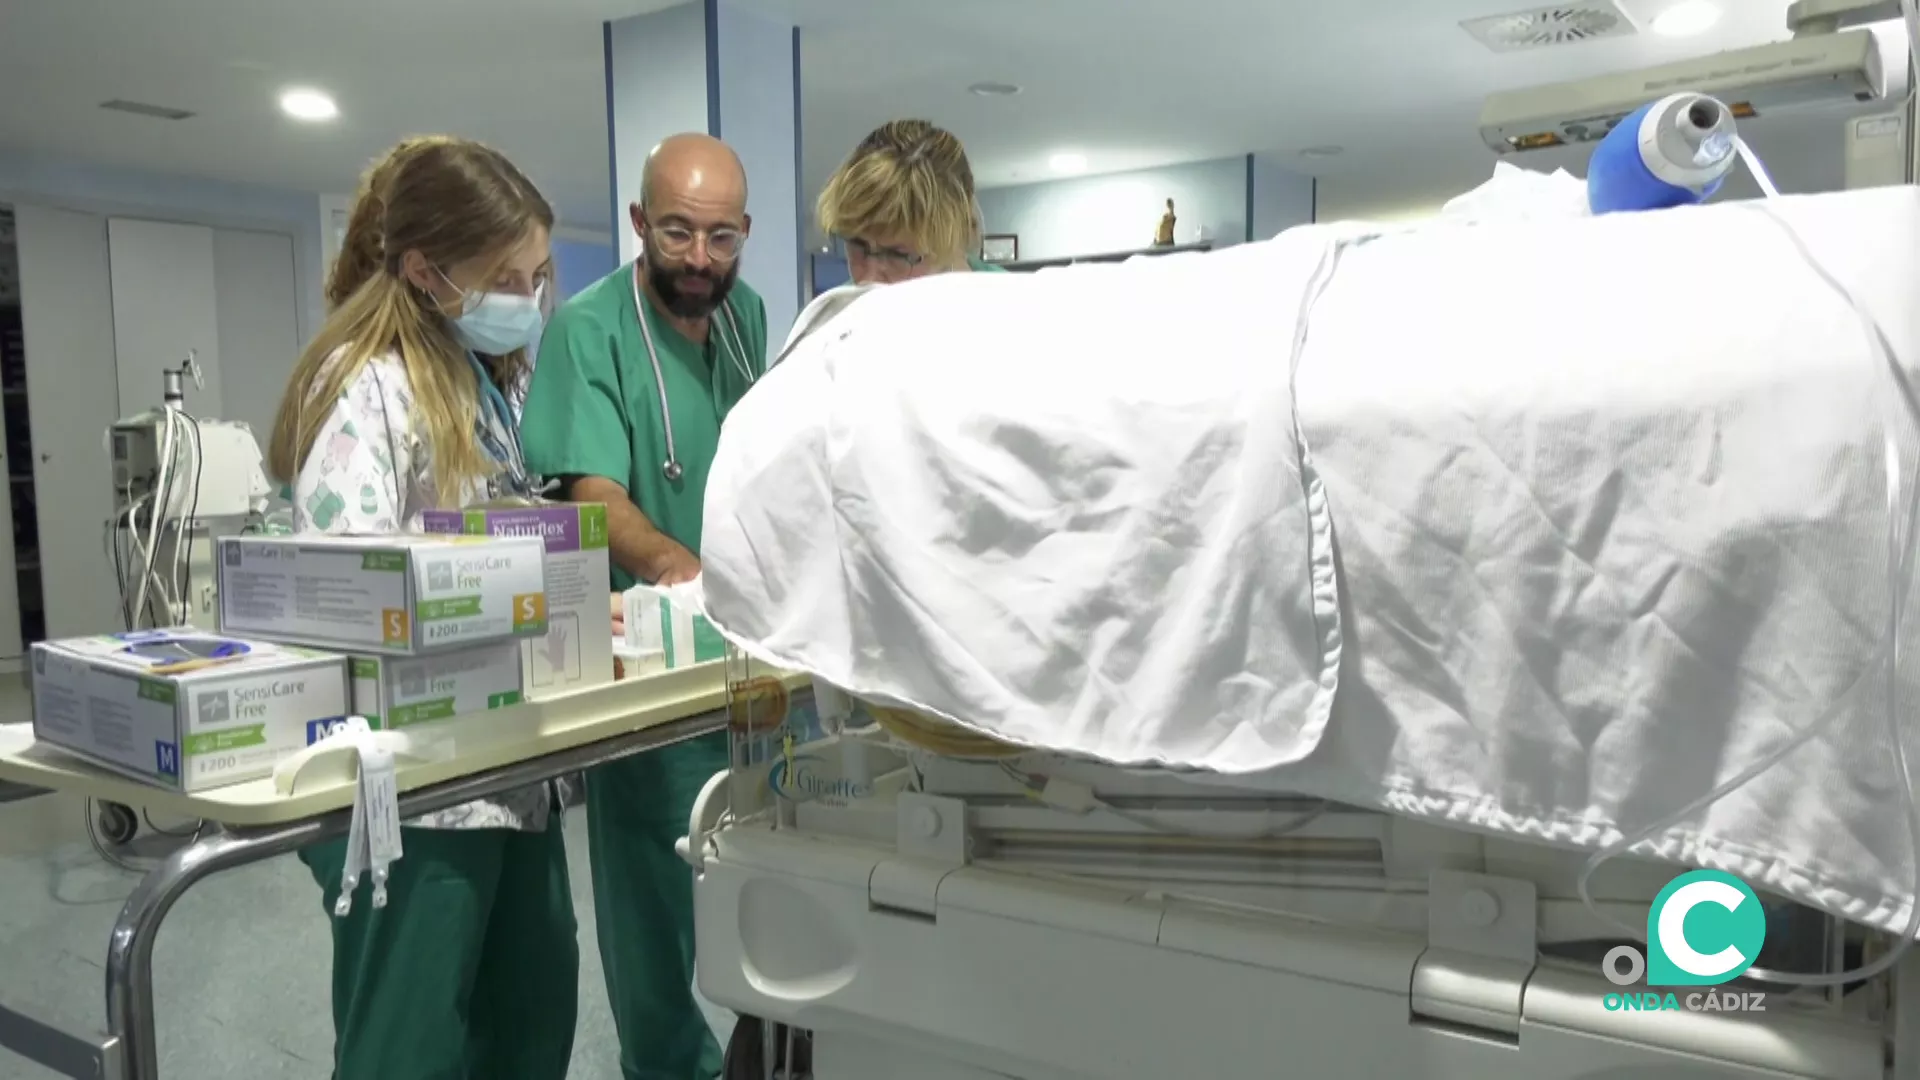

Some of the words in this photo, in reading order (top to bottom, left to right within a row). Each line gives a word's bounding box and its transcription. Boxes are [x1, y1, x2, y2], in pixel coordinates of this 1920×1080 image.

[493, 521, 565, 537] Naturflex
[456, 556, 512, 572] SensiCare
[457, 574, 482, 589] Free
[522, 595, 536, 621] S
[389, 613, 402, 638] S
[435, 622, 458, 638] 200
[233, 680, 305, 701] SensiCare
[430, 678, 456, 693] Free
[235, 703, 267, 719] Free
[160, 744, 175, 771] M
[208, 756, 236, 772] 200
[797, 765, 863, 799] Giraffe
